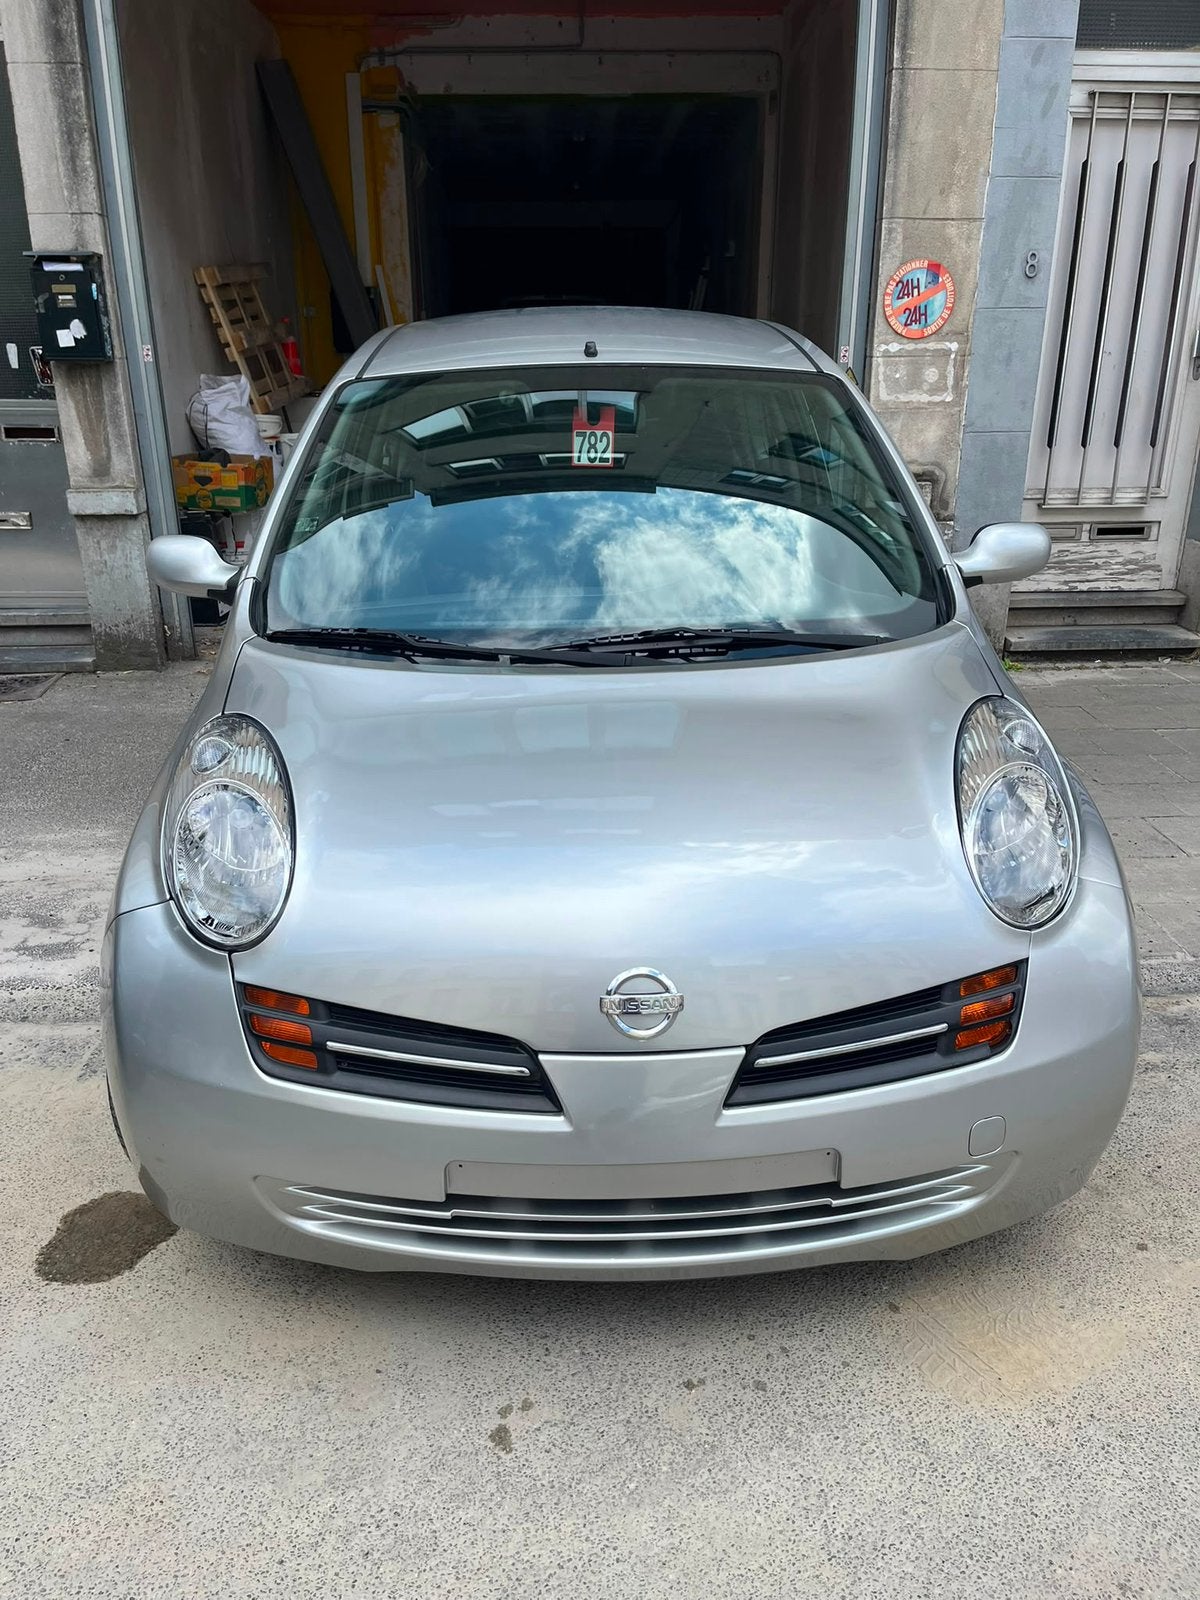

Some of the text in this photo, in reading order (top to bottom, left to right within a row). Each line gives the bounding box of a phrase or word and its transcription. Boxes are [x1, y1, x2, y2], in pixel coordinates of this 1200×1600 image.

[893, 260, 929, 281] STATIONNER
[1025, 250, 1038, 278] 8
[886, 280, 896, 294] PAS
[896, 277, 921, 300] 24H
[884, 305, 894, 316] DE
[903, 304, 928, 327] 24H
[923, 274, 955, 336] SORTIE DE VOITURES
[576, 430, 610, 464] 782
[603, 997, 678, 1012] NISSAN
